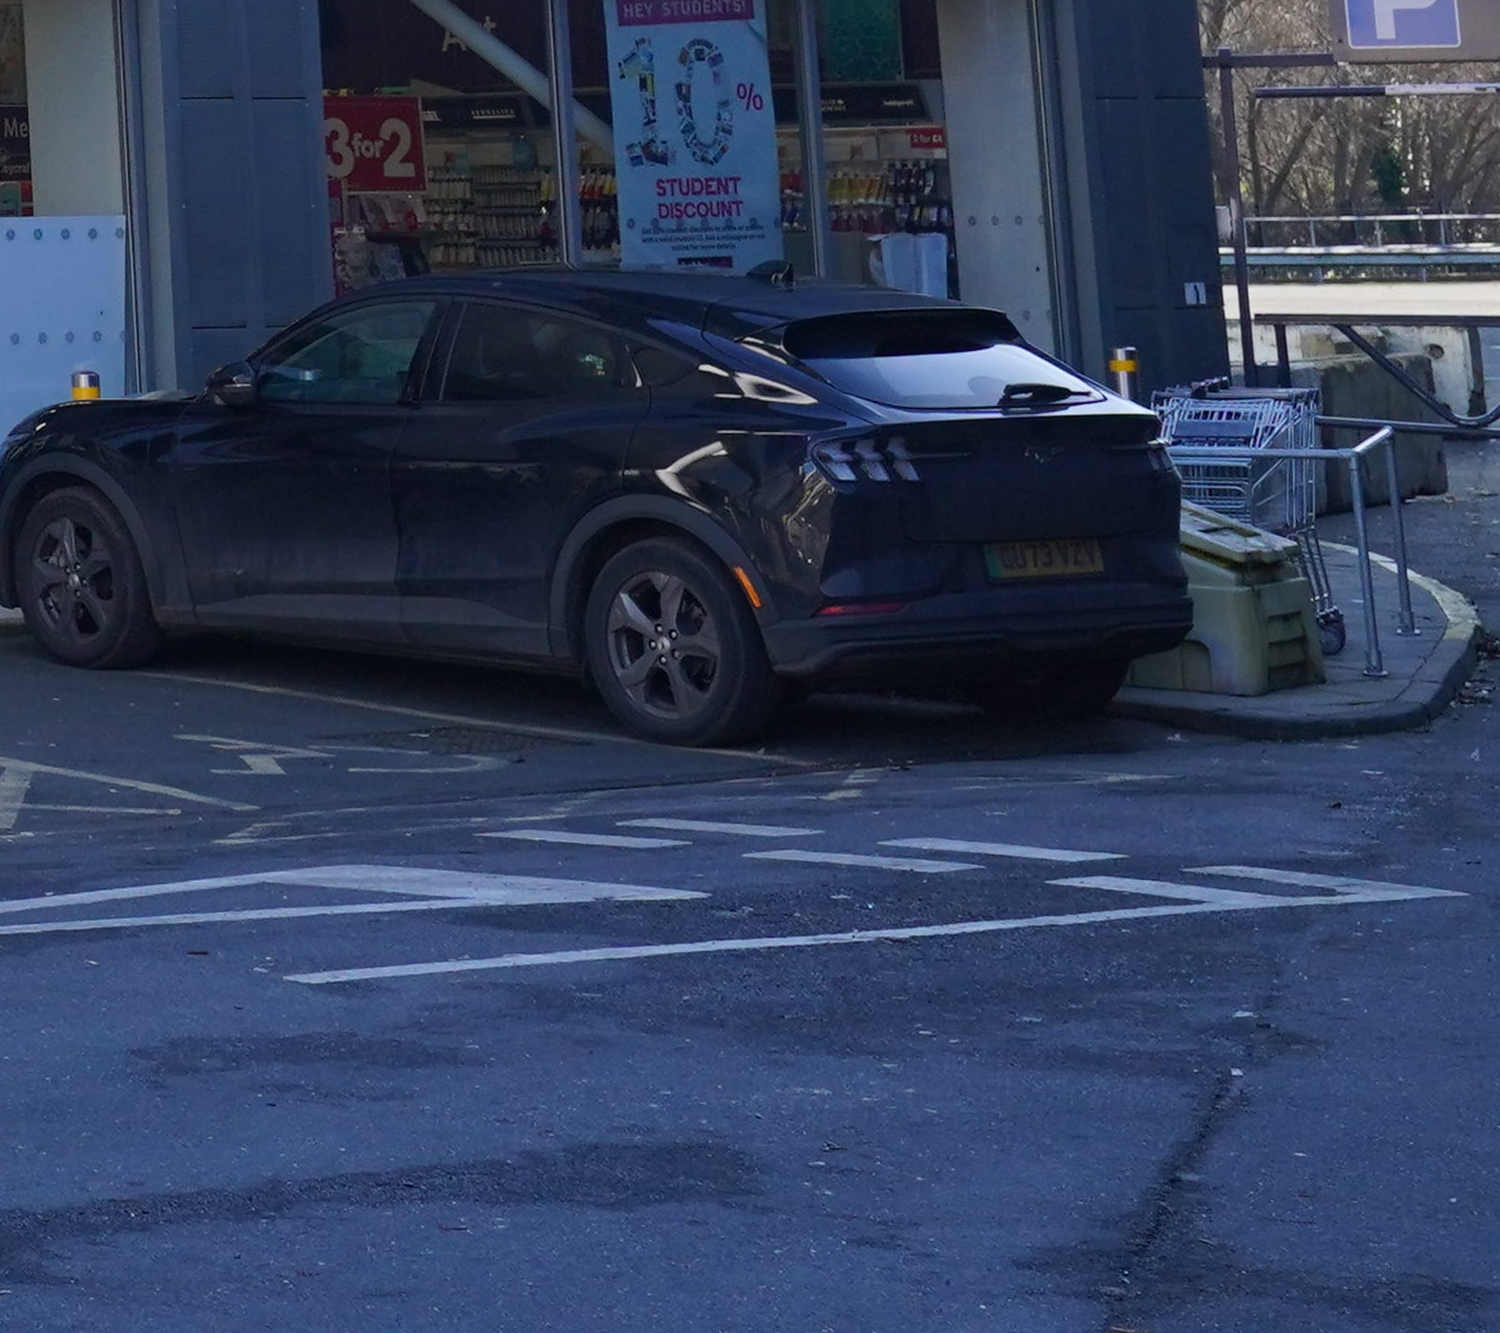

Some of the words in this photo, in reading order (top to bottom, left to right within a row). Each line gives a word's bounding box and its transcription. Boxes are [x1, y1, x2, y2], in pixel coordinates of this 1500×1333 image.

[622, 1, 653, 18] HEY
[324, 117, 355, 180] 3
[352, 133, 384, 158] for
[380, 117, 416, 178] 2
[655, 176, 742, 198] STUDENT
[657, 200, 744, 220] DISCOUNT
